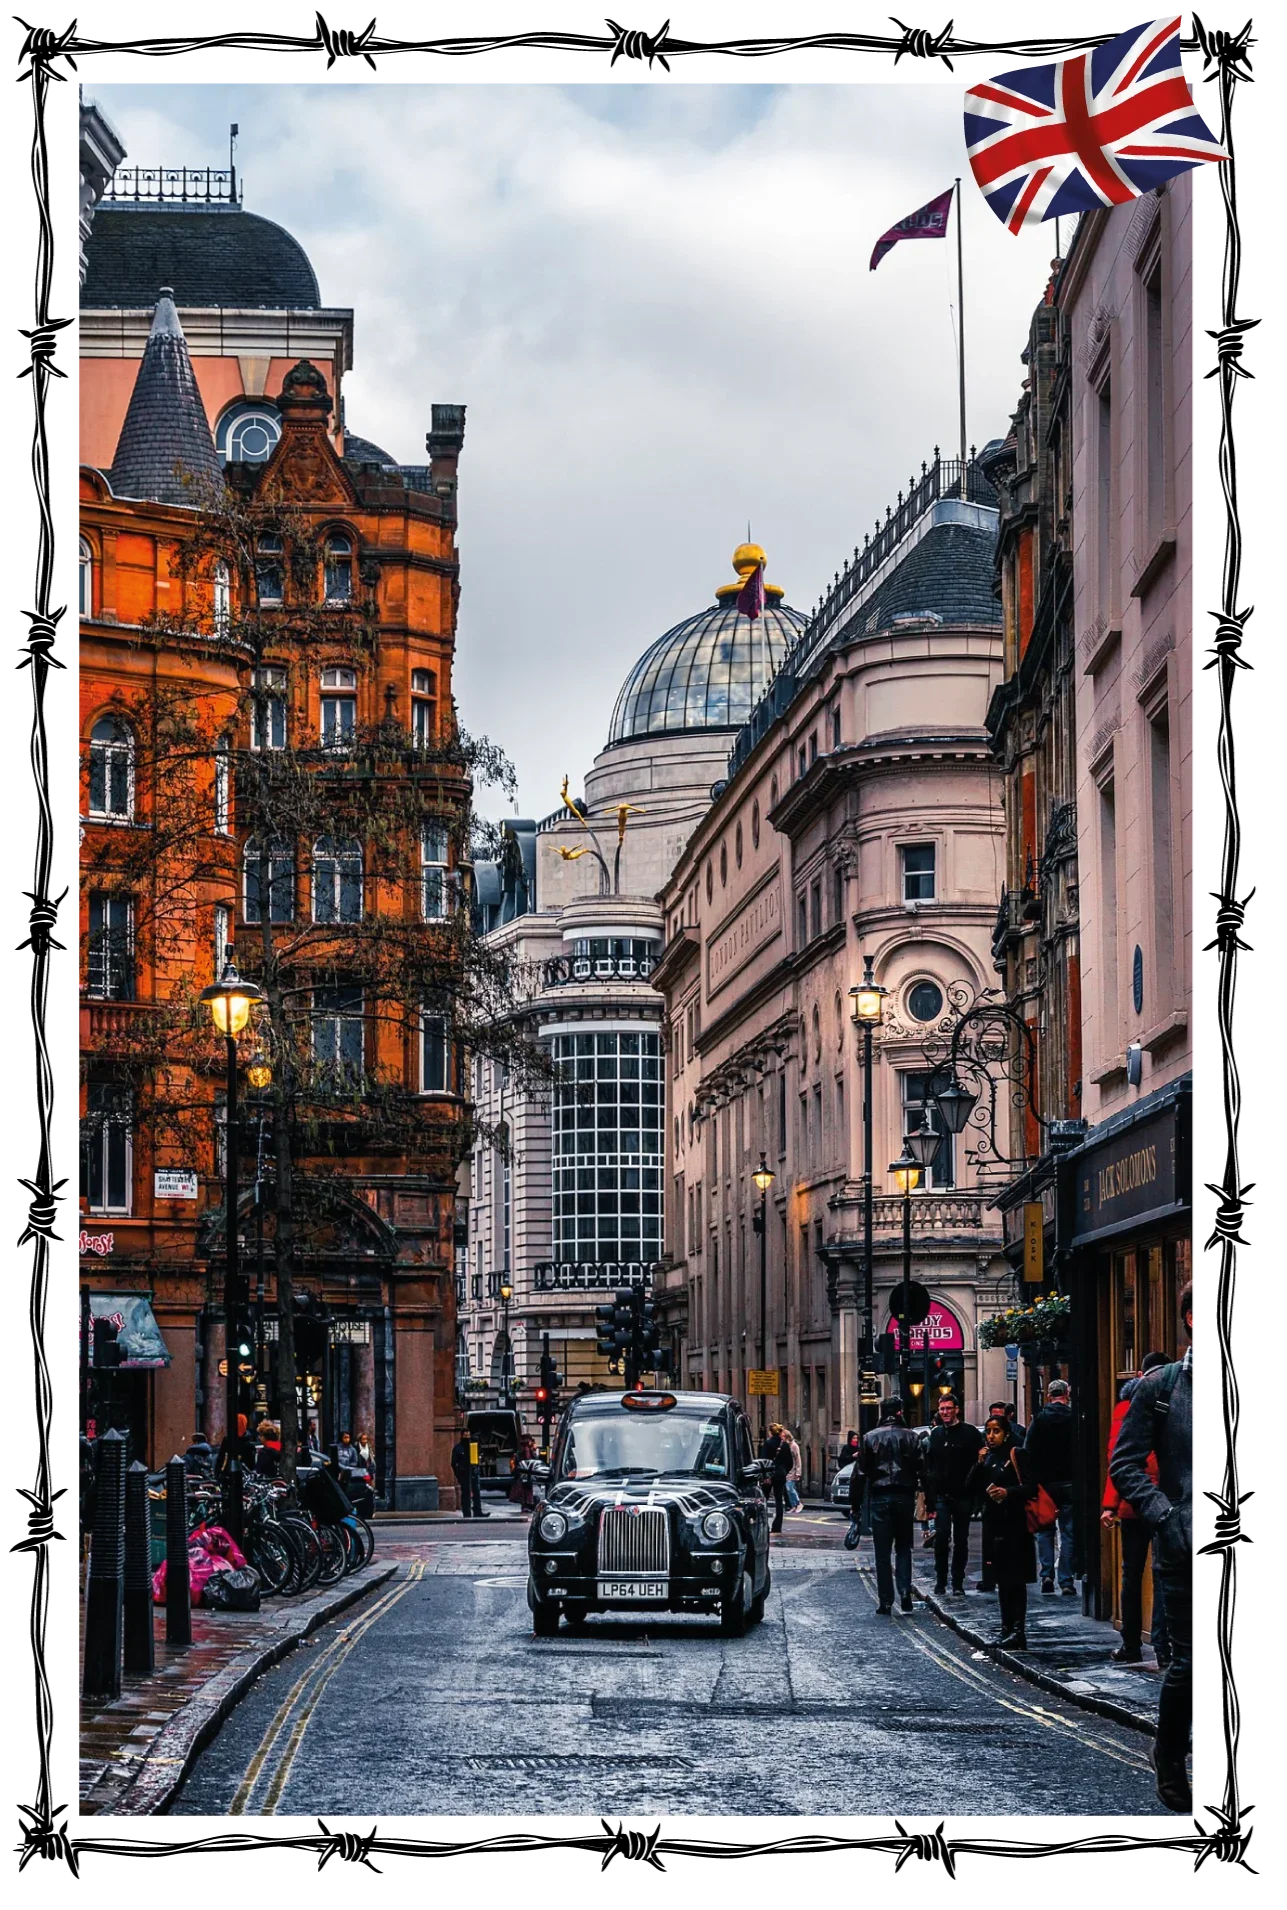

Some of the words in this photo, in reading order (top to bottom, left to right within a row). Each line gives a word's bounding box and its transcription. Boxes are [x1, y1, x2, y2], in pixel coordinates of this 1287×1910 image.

[711, 930, 738, 978] LONDON
[740, 886, 781, 948] PAVILION
[1098, 1164, 1115, 1210] JACK
[1115, 1144, 1156, 1195] SOLOMONS
[78, 1230, 114, 1256] forest
[603, 1584, 635, 1596] LP64
[639, 1584, 664, 1596] UEH
